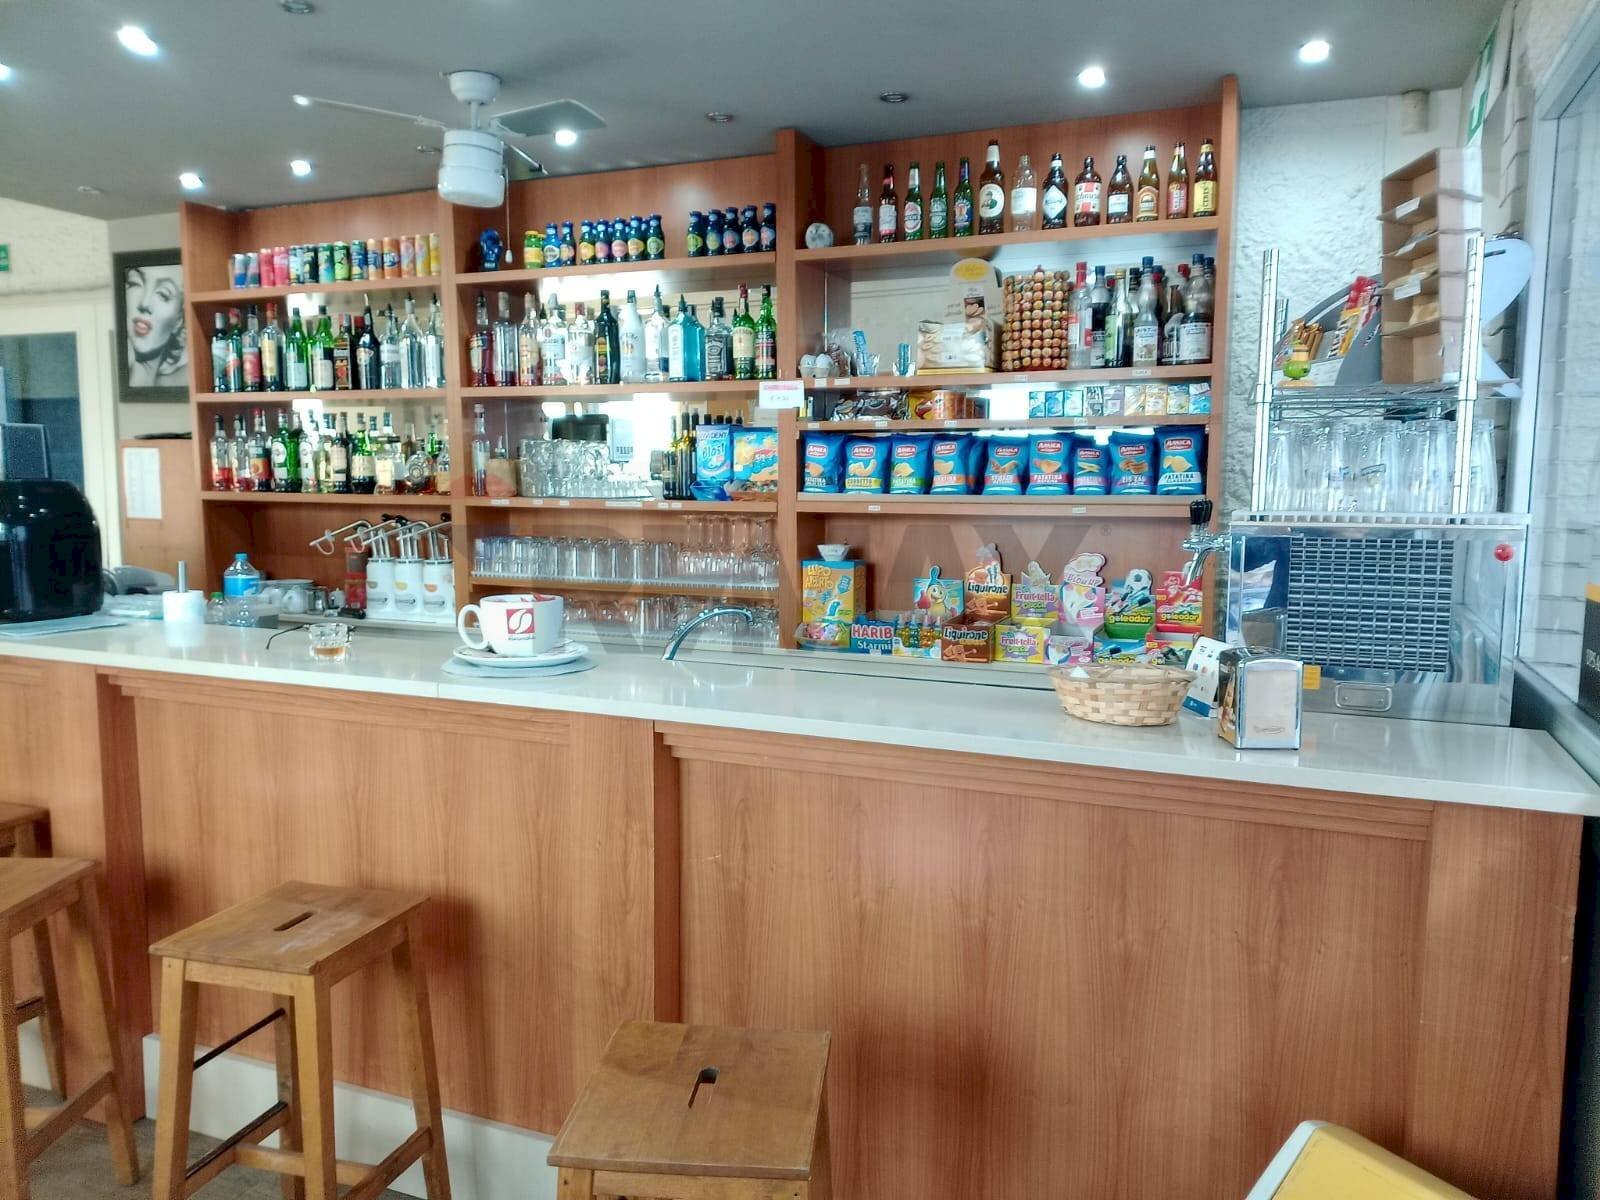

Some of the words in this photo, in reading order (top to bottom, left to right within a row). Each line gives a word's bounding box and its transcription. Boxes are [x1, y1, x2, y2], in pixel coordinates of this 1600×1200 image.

[967, 581, 1009, 594] Liquirone
[1108, 613, 1151, 624] goleador
[1160, 611, 1200, 622] goleador
[851, 624, 893, 639] HARIB
[943, 626, 989, 640] Liquirone
[857, 640, 892, 650] Starmi
